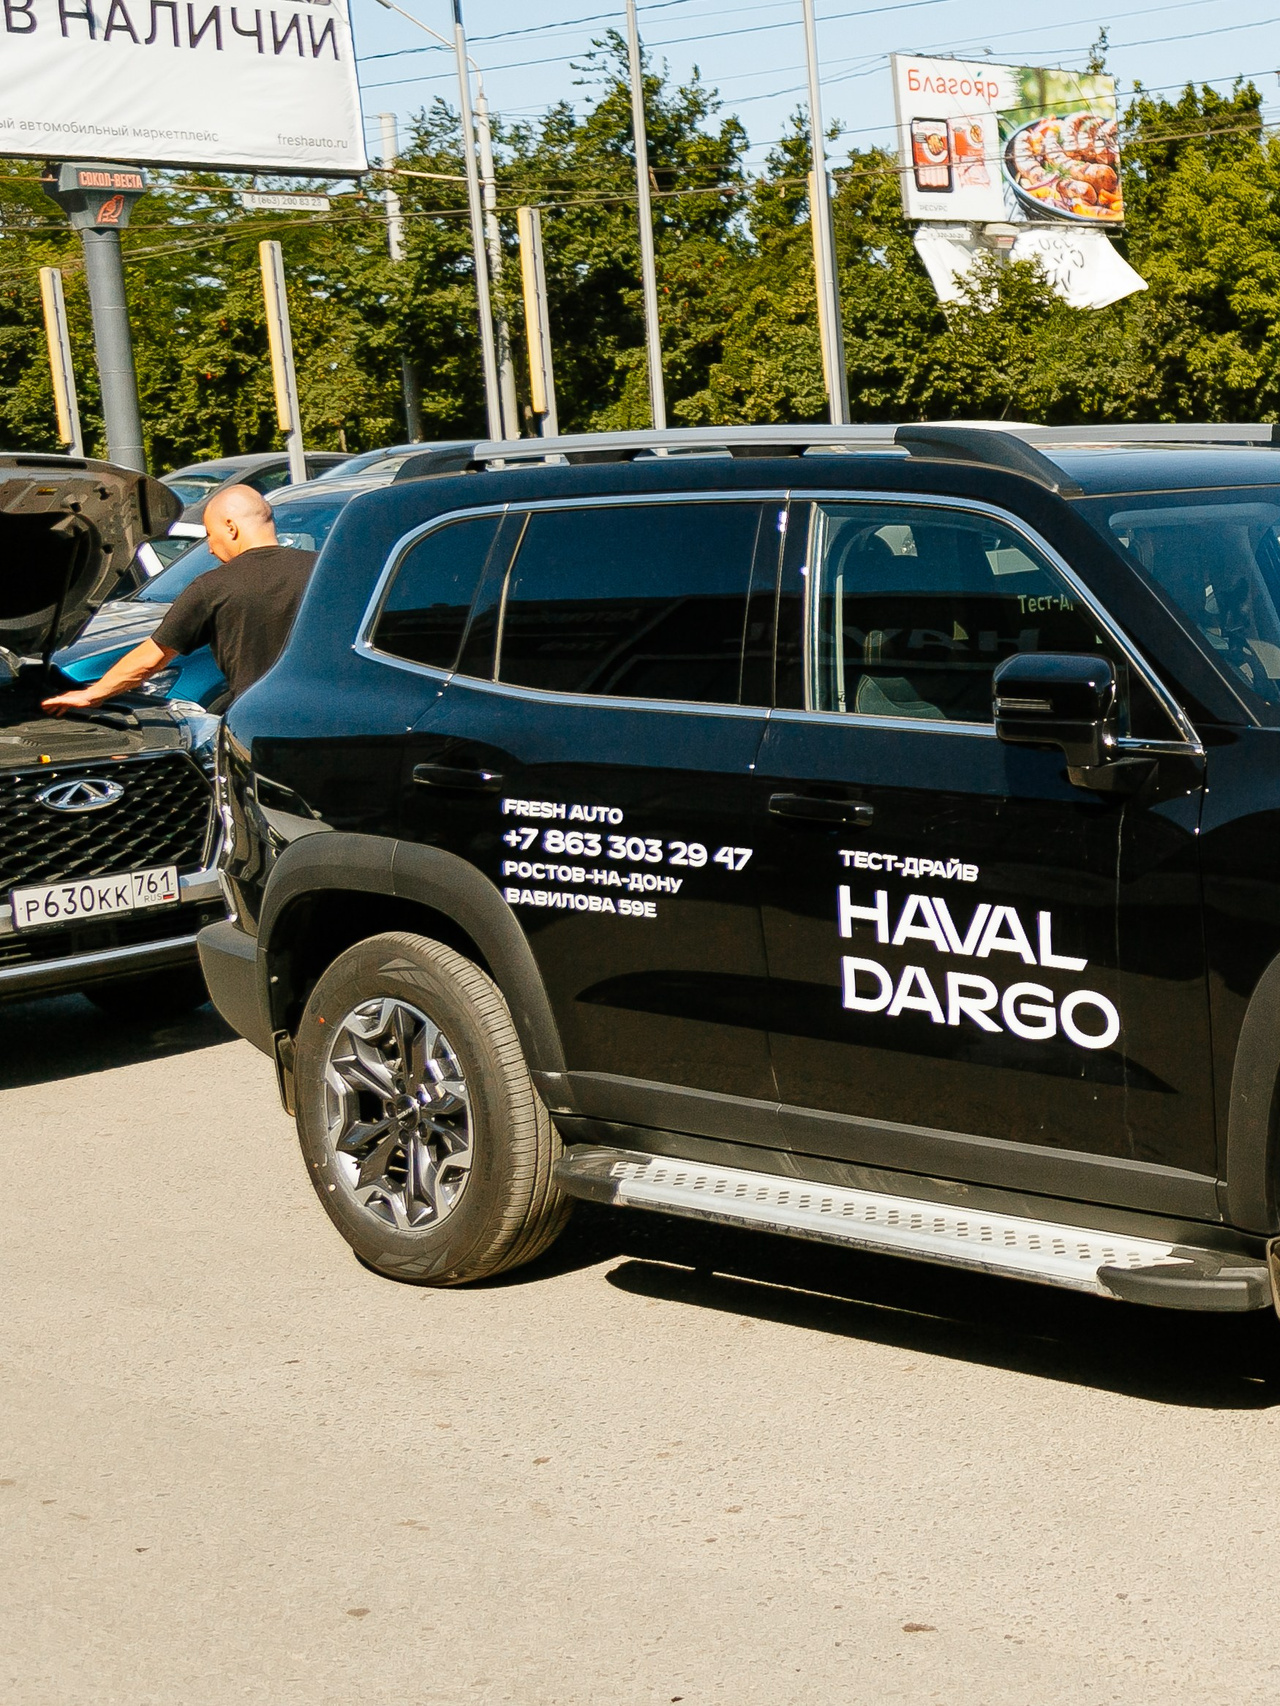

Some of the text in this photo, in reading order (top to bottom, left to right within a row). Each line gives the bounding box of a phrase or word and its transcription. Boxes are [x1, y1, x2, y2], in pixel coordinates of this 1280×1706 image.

[4, 0, 340, 61] В НАЛИЧИИ
[908, 69, 999, 106] Благояр
[19, 120, 129, 137] автомобильный
[133, 128, 219, 142] маркетплейс
[277, 134, 348, 149] freshauto.ru
[79, 171, 144, 189] СОКОЛ-ВЕСТА
[503, 798, 623, 825] FRESH AUTO
[503, 827, 753, 871] +7 863 303 29 47
[503, 860, 683, 894] РОСТОВ-НА-ДОНУ
[839, 849, 979, 882] ТЕСТ-ДРАЙВ
[134, 871, 175, 896] 761
[144, 893, 162, 904] RUS
[504, 887, 616, 914] ВАВИЛОВА
[838, 884, 1088, 972] HAVAL
[842, 955, 1120, 1050] DARGO
